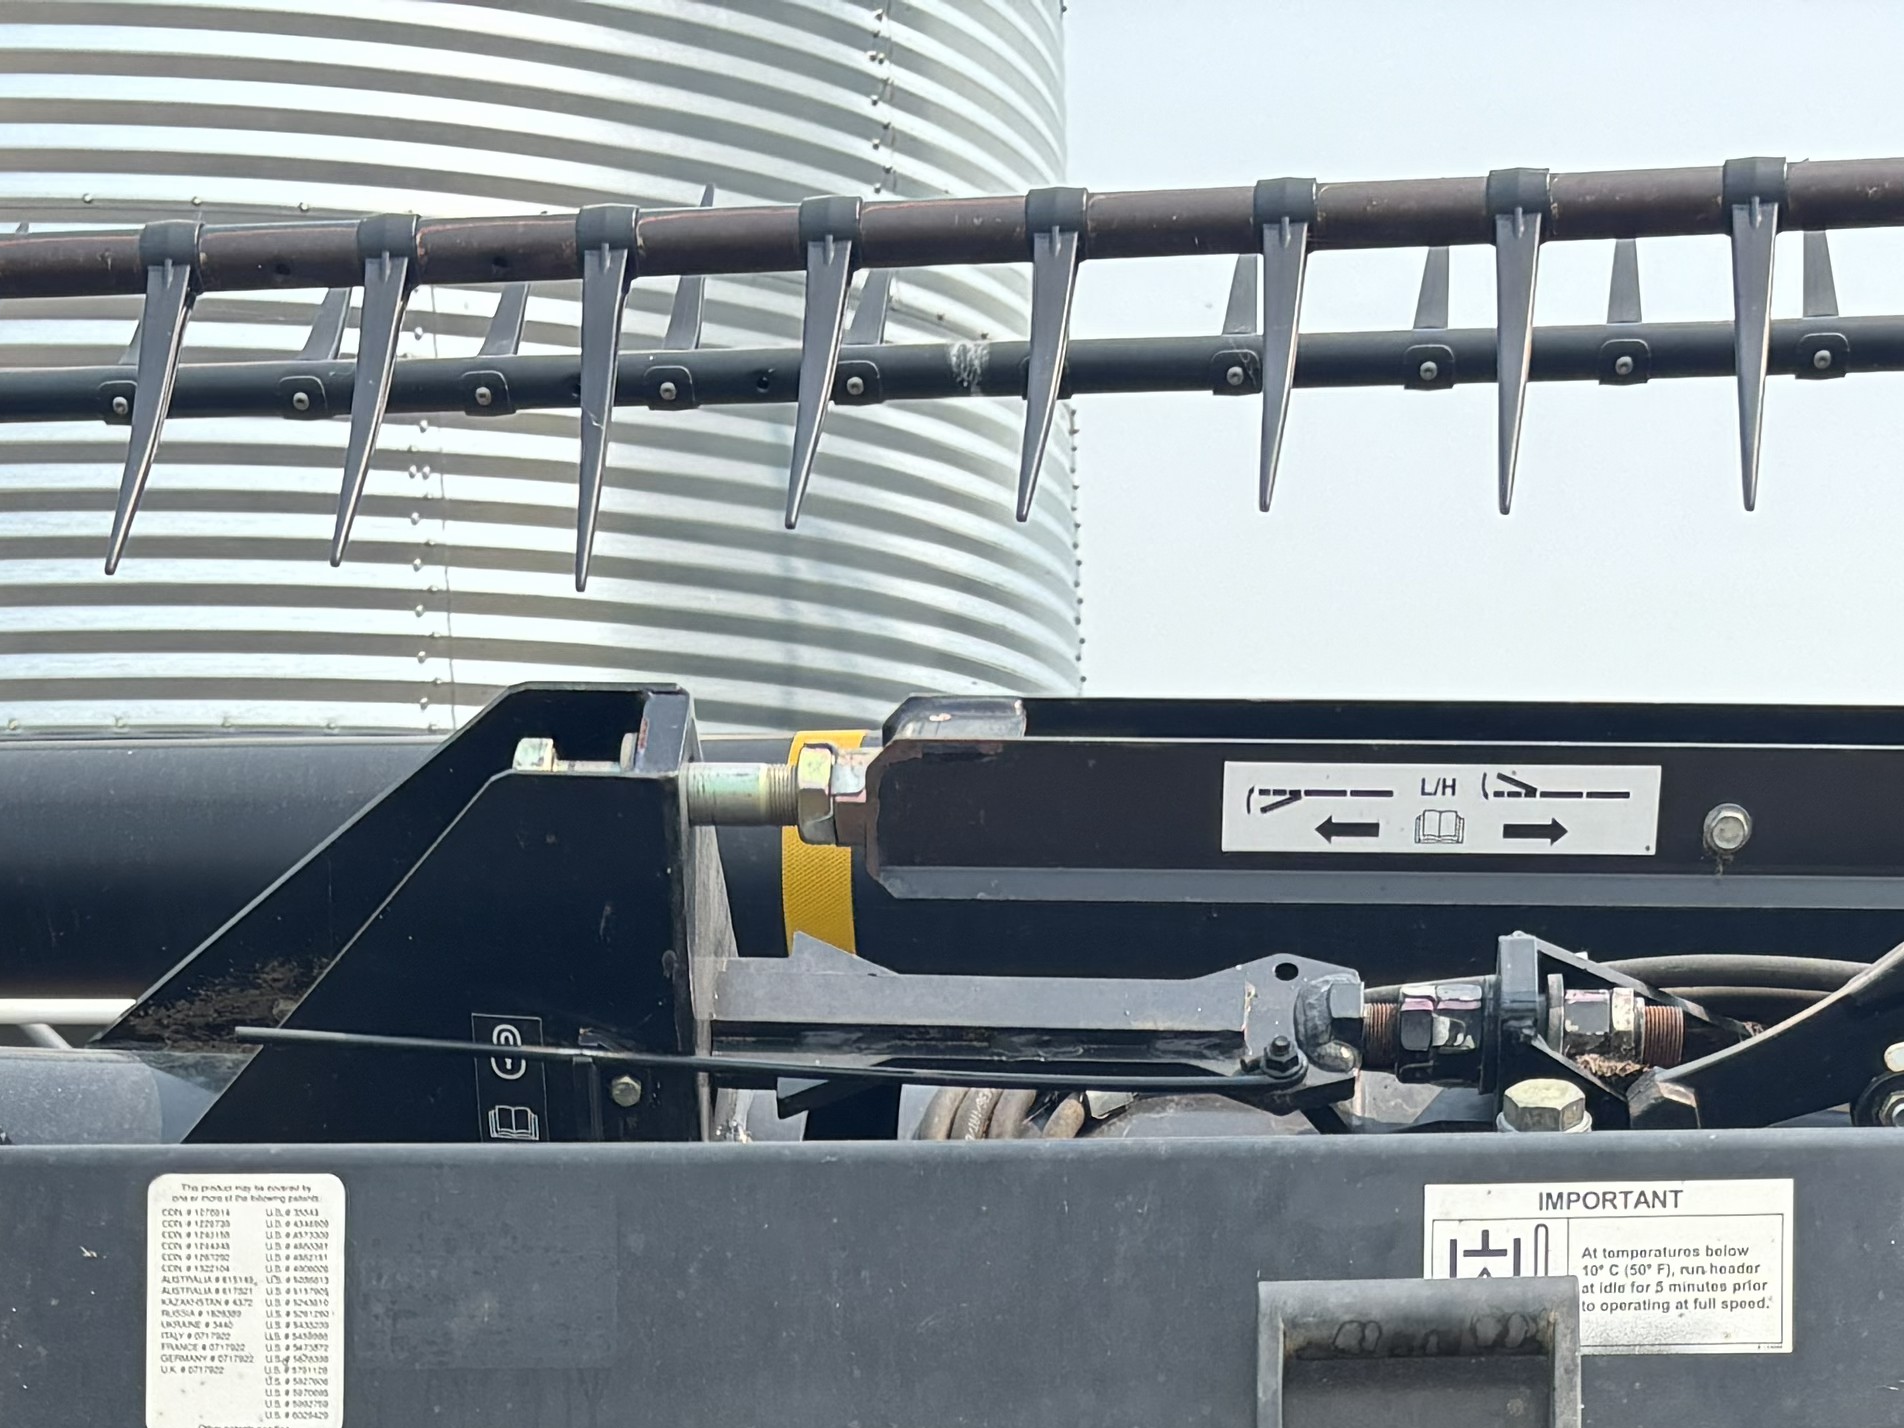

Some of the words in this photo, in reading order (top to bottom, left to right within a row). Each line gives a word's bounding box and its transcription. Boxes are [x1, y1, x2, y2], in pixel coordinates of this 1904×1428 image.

[1421, 777, 1457, 797] L/H
[1538, 1190, 1684, 1211] IMPORTANT
[1581, 1247, 1598, 1259] At
[1603, 1247, 1700, 1260] temperatures
[1705, 1245, 1749, 1257] below
[1609, 1264, 1619, 1276] C
[1680, 1265, 1706, 1275] run
[1710, 1262, 1761, 1274] header
[1581, 1283, 1595, 1294] at
[1599, 1281, 1625, 1294] idle
[1630, 1281, 1651, 1294] for
[1655, 1281, 1663, 1294] 5
[1669, 1281, 1727, 1293] minutes
[1732, 1279, 1768, 1294] prior
[1581, 1300, 1595, 1312] to
[1600, 1299, 1670, 1315] operating
[1675, 1299, 1689, 1311] at
[1693, 1297, 1716, 1310] full
[1721, 1296, 1770, 1312] speed.
